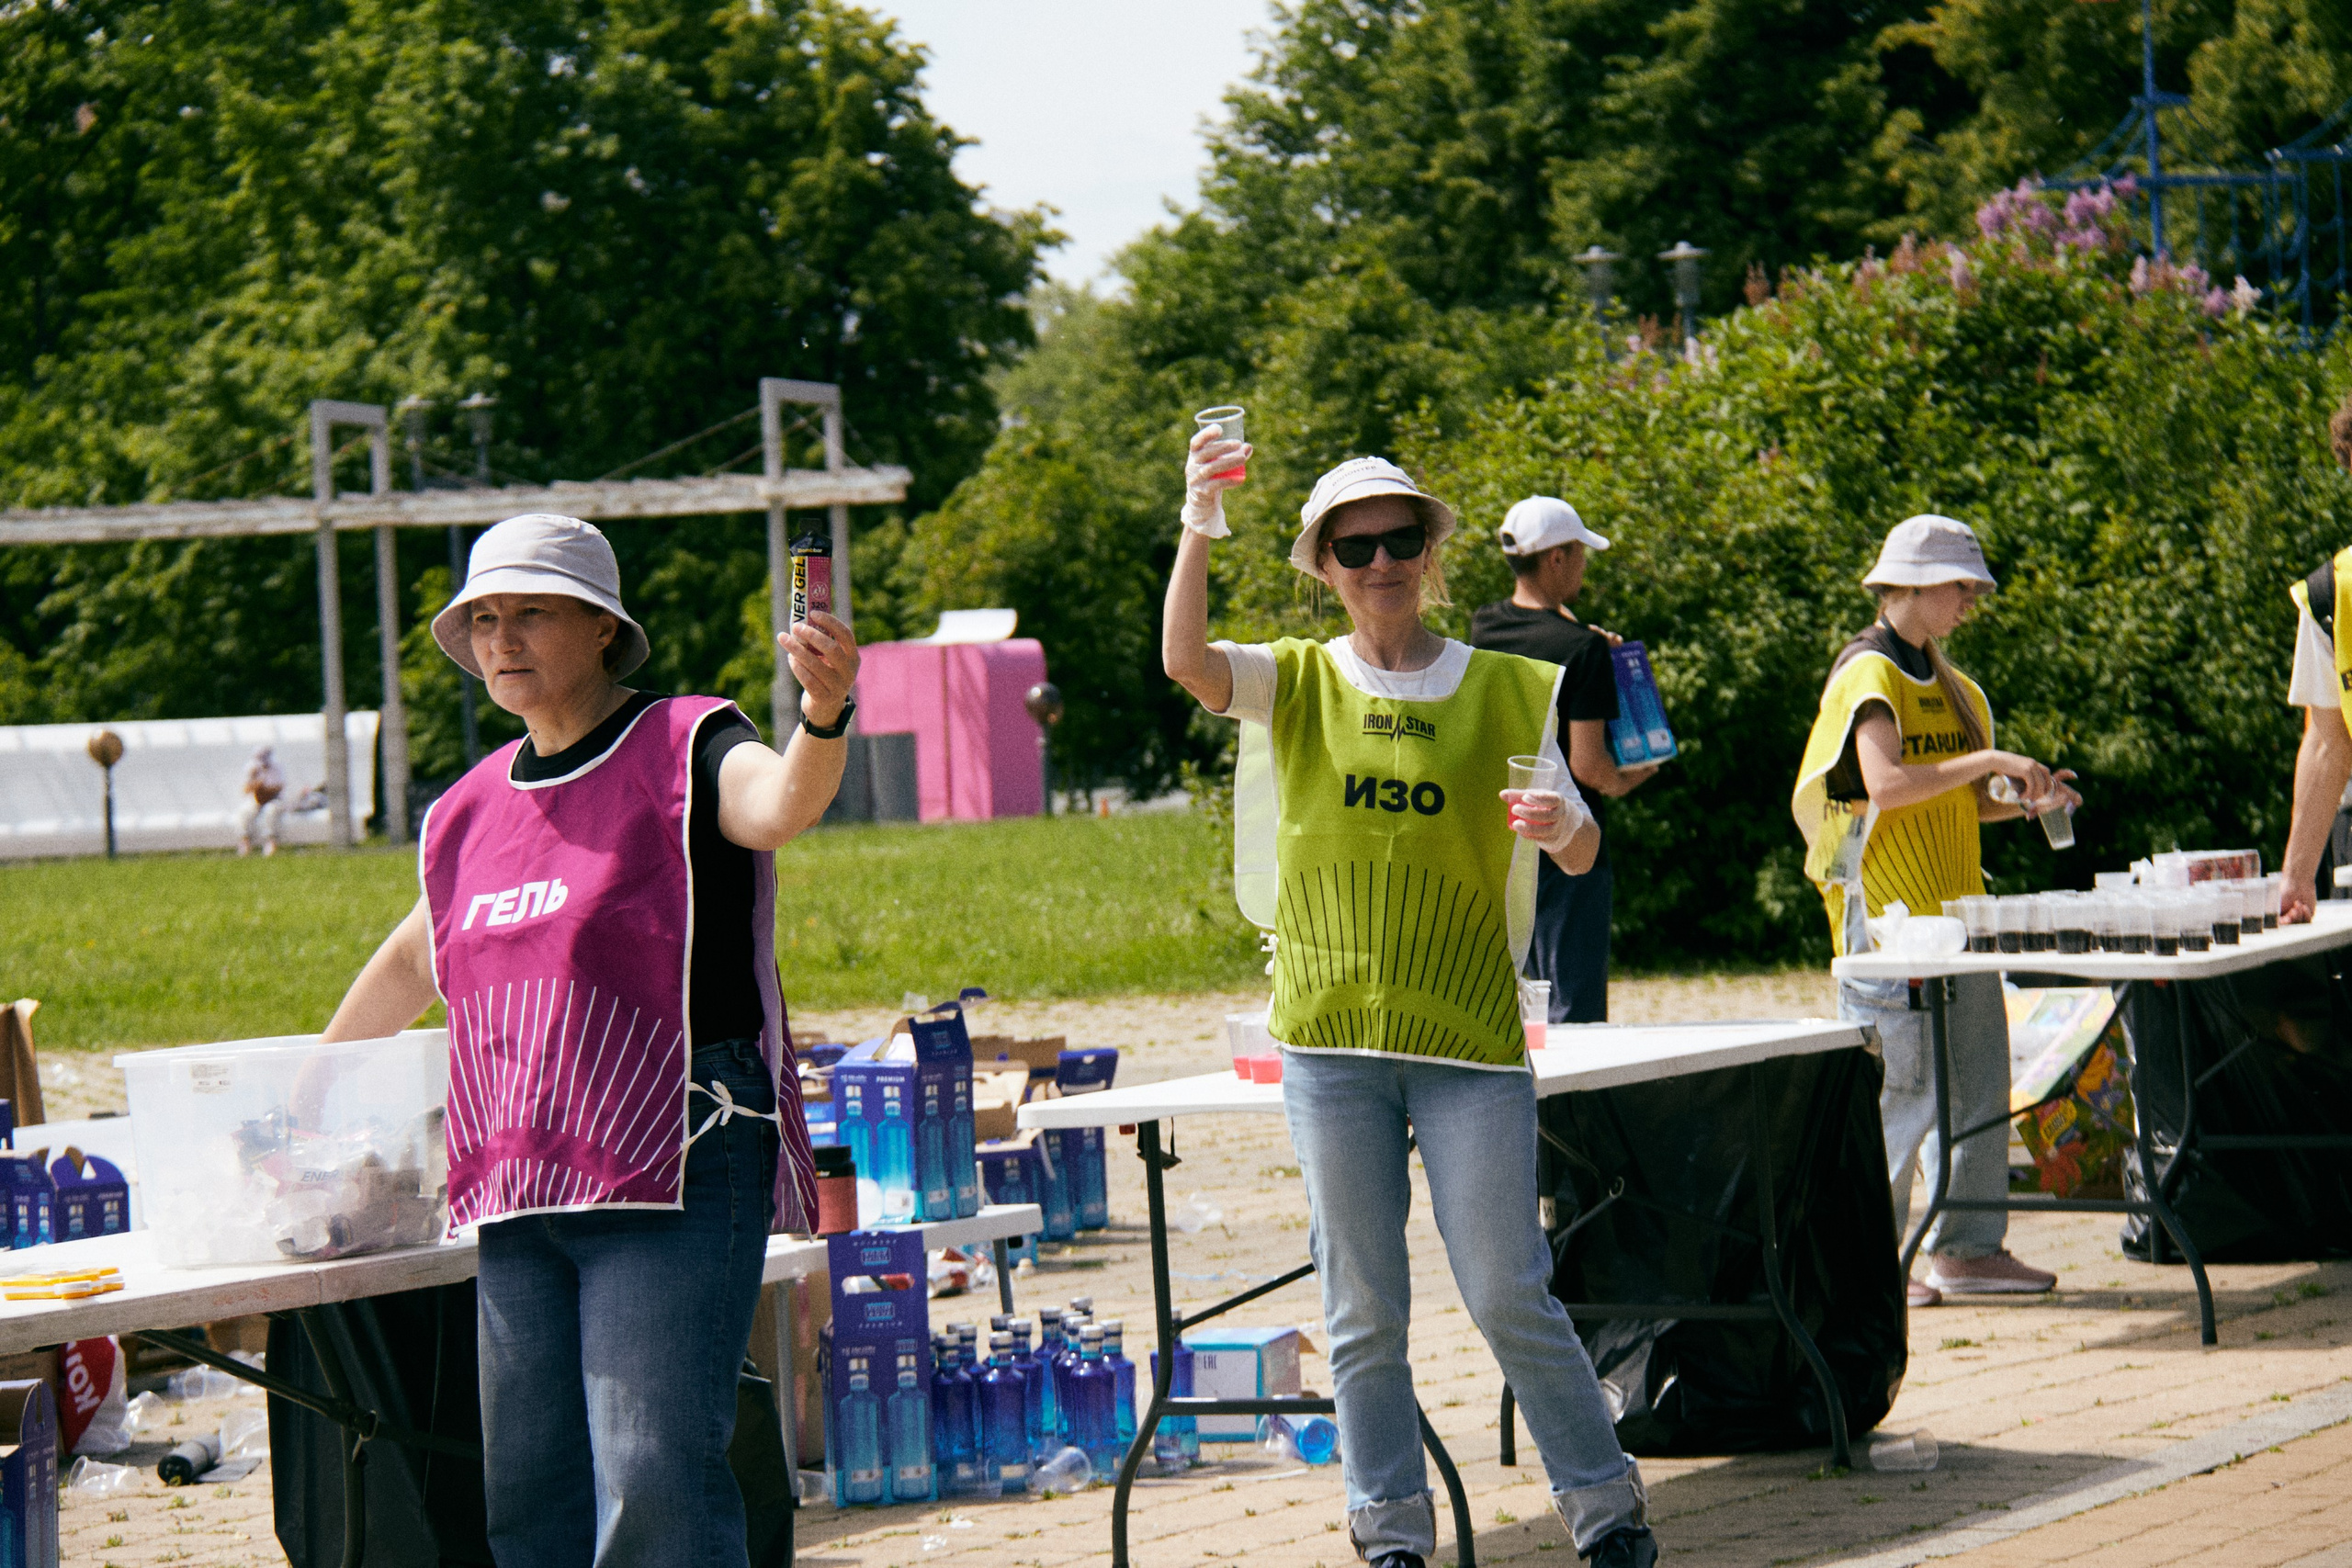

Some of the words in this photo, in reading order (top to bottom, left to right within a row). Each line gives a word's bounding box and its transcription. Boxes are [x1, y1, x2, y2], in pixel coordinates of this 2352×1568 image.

[795, 558, 806, 590] GEL
[1363, 714, 1393, 729] IRON
[1406, 716, 1435, 737] STAR
[1344, 773, 1445, 816] ИЗО
[461, 878, 569, 931] ГЕЛЬ
